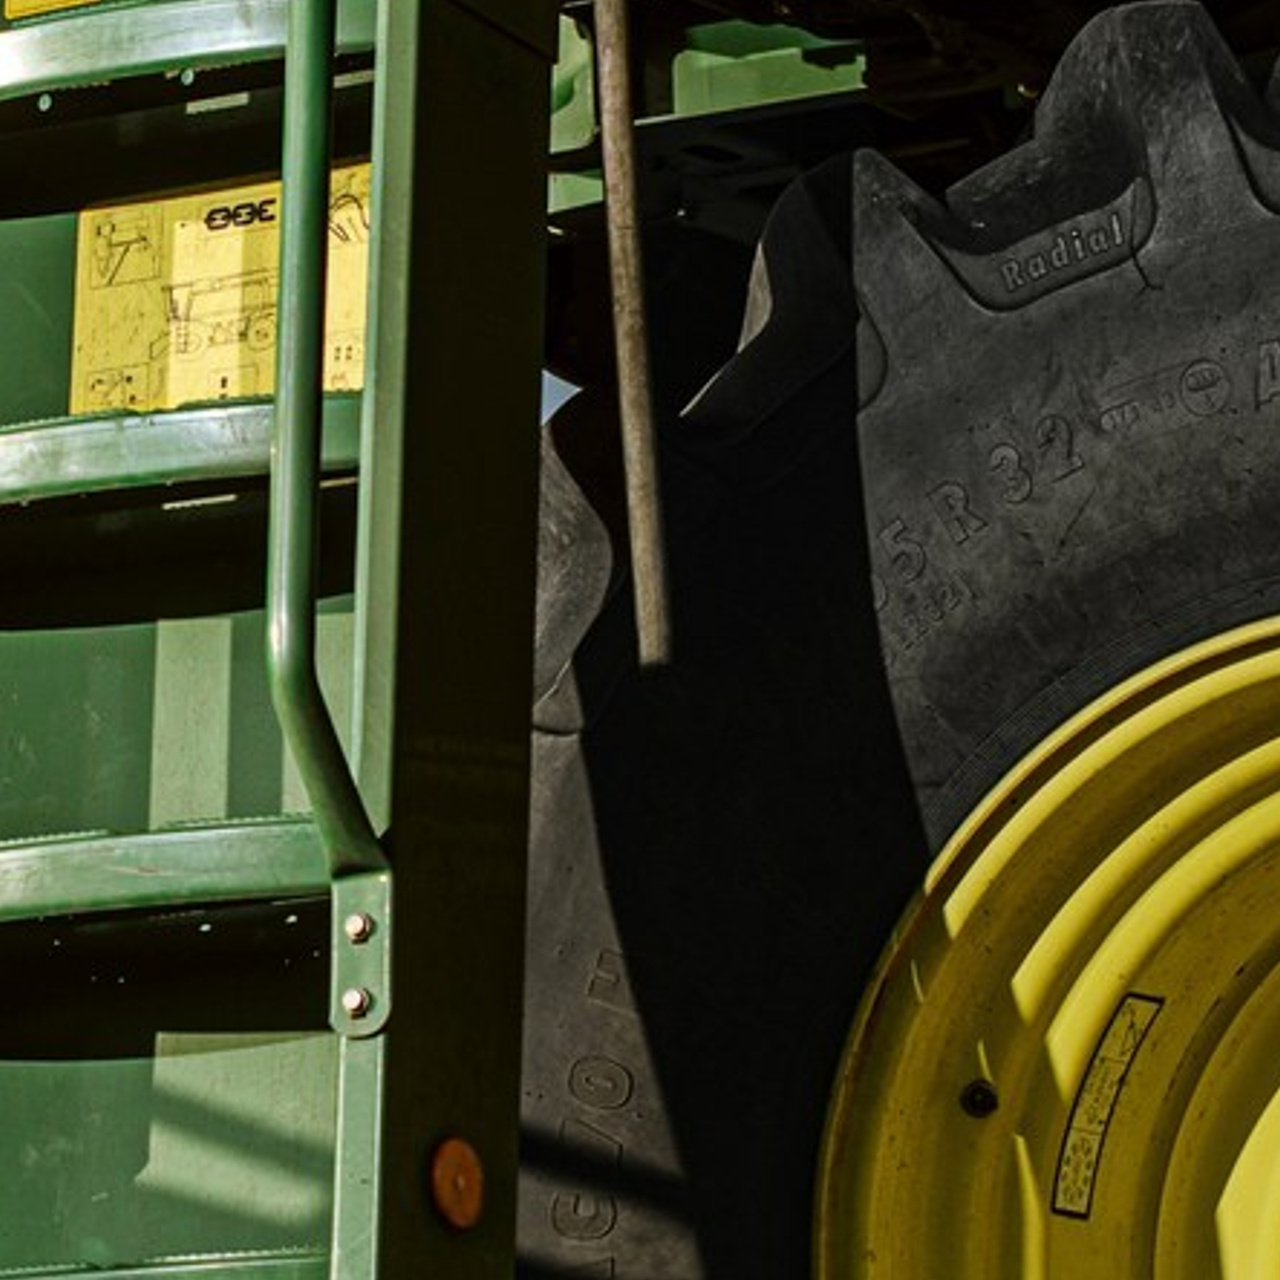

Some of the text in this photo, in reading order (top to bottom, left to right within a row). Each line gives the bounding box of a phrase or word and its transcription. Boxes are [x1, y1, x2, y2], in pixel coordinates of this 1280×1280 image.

[1000, 213, 1123, 292] Radial
[925, 481, 989, 546] R
[988, 415, 1085, 505] 32
